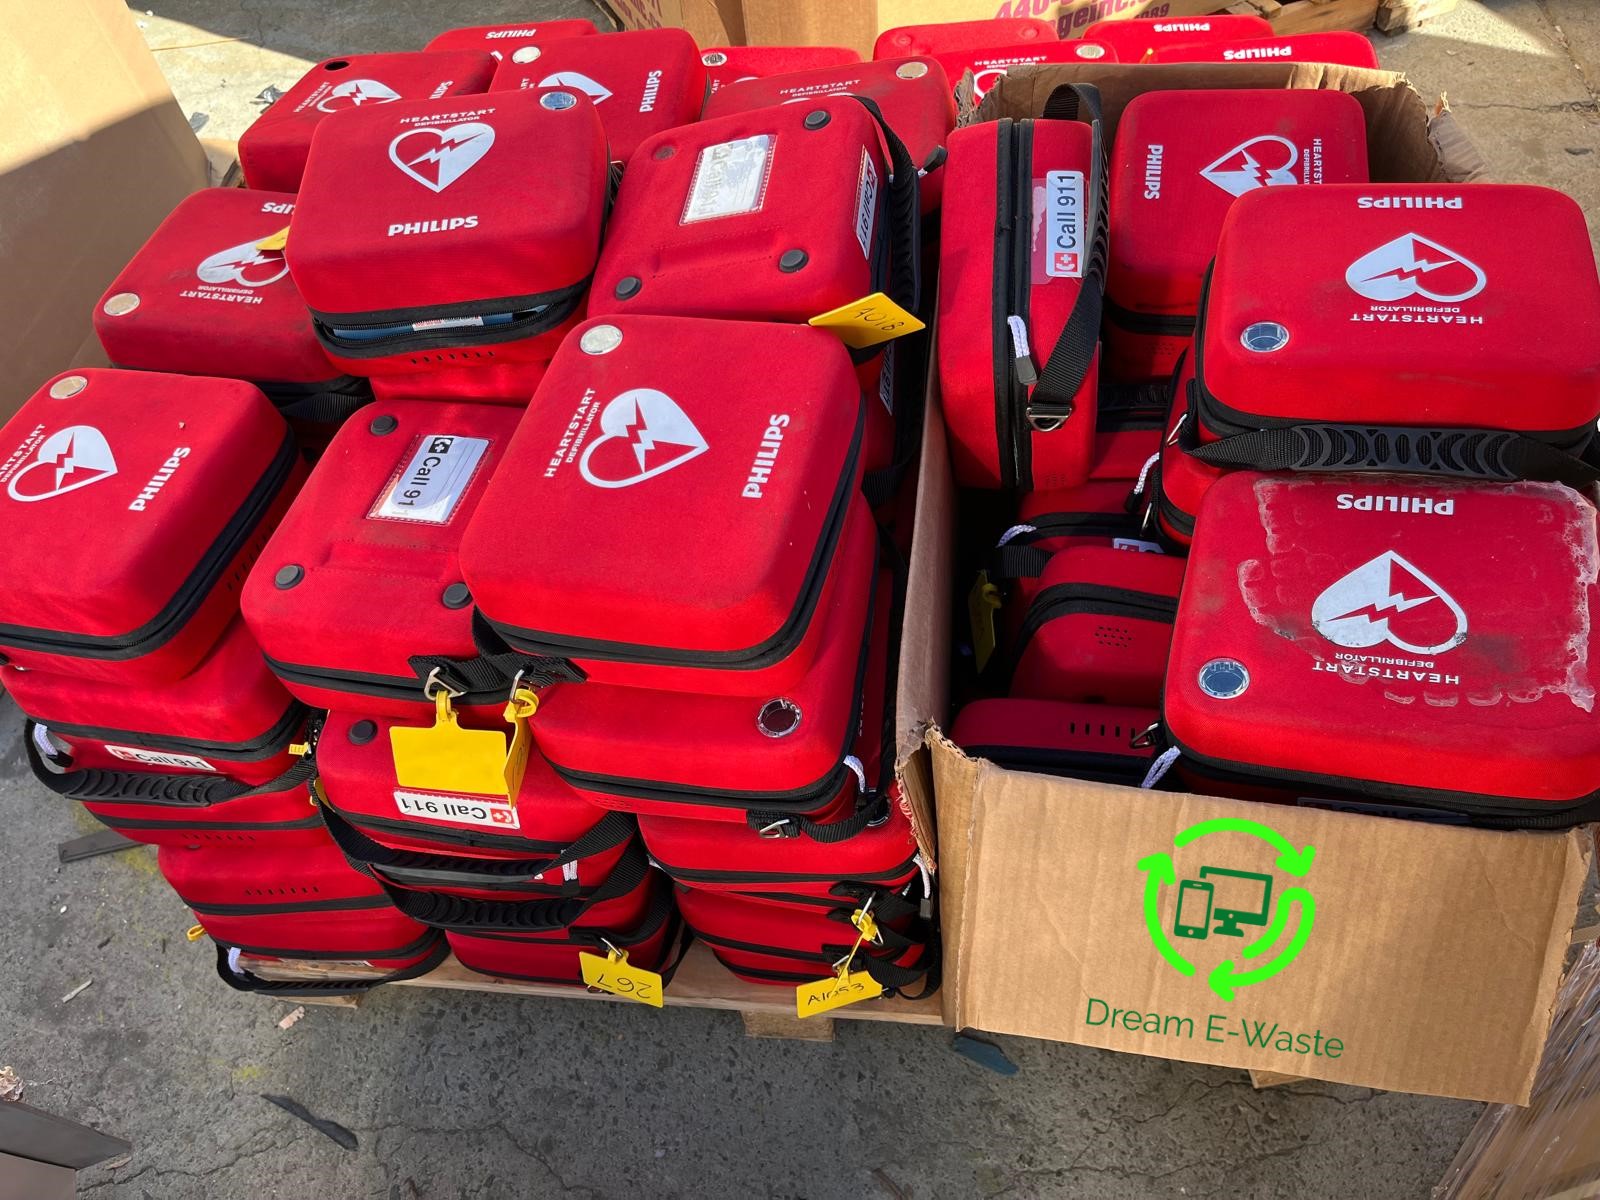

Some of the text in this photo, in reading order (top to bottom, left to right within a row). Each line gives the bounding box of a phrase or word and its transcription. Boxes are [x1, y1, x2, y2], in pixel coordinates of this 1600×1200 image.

[485, 29, 536, 39] PHILIPS
[1153, 23, 1210, 32] PHILIPS
[1223, 46, 1292, 60] PHILIPS
[639, 69, 662, 112] PHILIPS
[779, 80, 860, 94] HEARTSTART
[400, 108, 496, 124] HEARTSTART
[414, 116, 480, 127] DEFIBRILLATOR
[1144, 145, 1163, 199] PHILIPS
[863, 180, 873, 218] Call
[1357, 197, 1463, 209] PHILIPS
[1056, 176, 1076, 249] Call 911
[388, 216, 478, 236] PHILIPS
[180, 290, 264, 304] HEARTSTART
[1350, 313, 1483, 324] HEARTSTART
[1370, 305, 1460, 313] DEFIBRILLATOR
[544, 388, 595, 477] HEARTSTART
[565, 402, 600, 463] DEFIBRILLATOR
[742, 414, 790, 498] PHILIPS
[128, 447, 191, 511] PHILIPS
[410, 456, 441, 486] Call
[1336, 494, 1454, 515] PHILIPS
[1335, 652, 1434, 669] DEFIBRILLATOR
[1312, 661, 1459, 685] HEARTSTART
[401, 798, 487, 820] Call 911
[597, 973, 652, 999] 267
